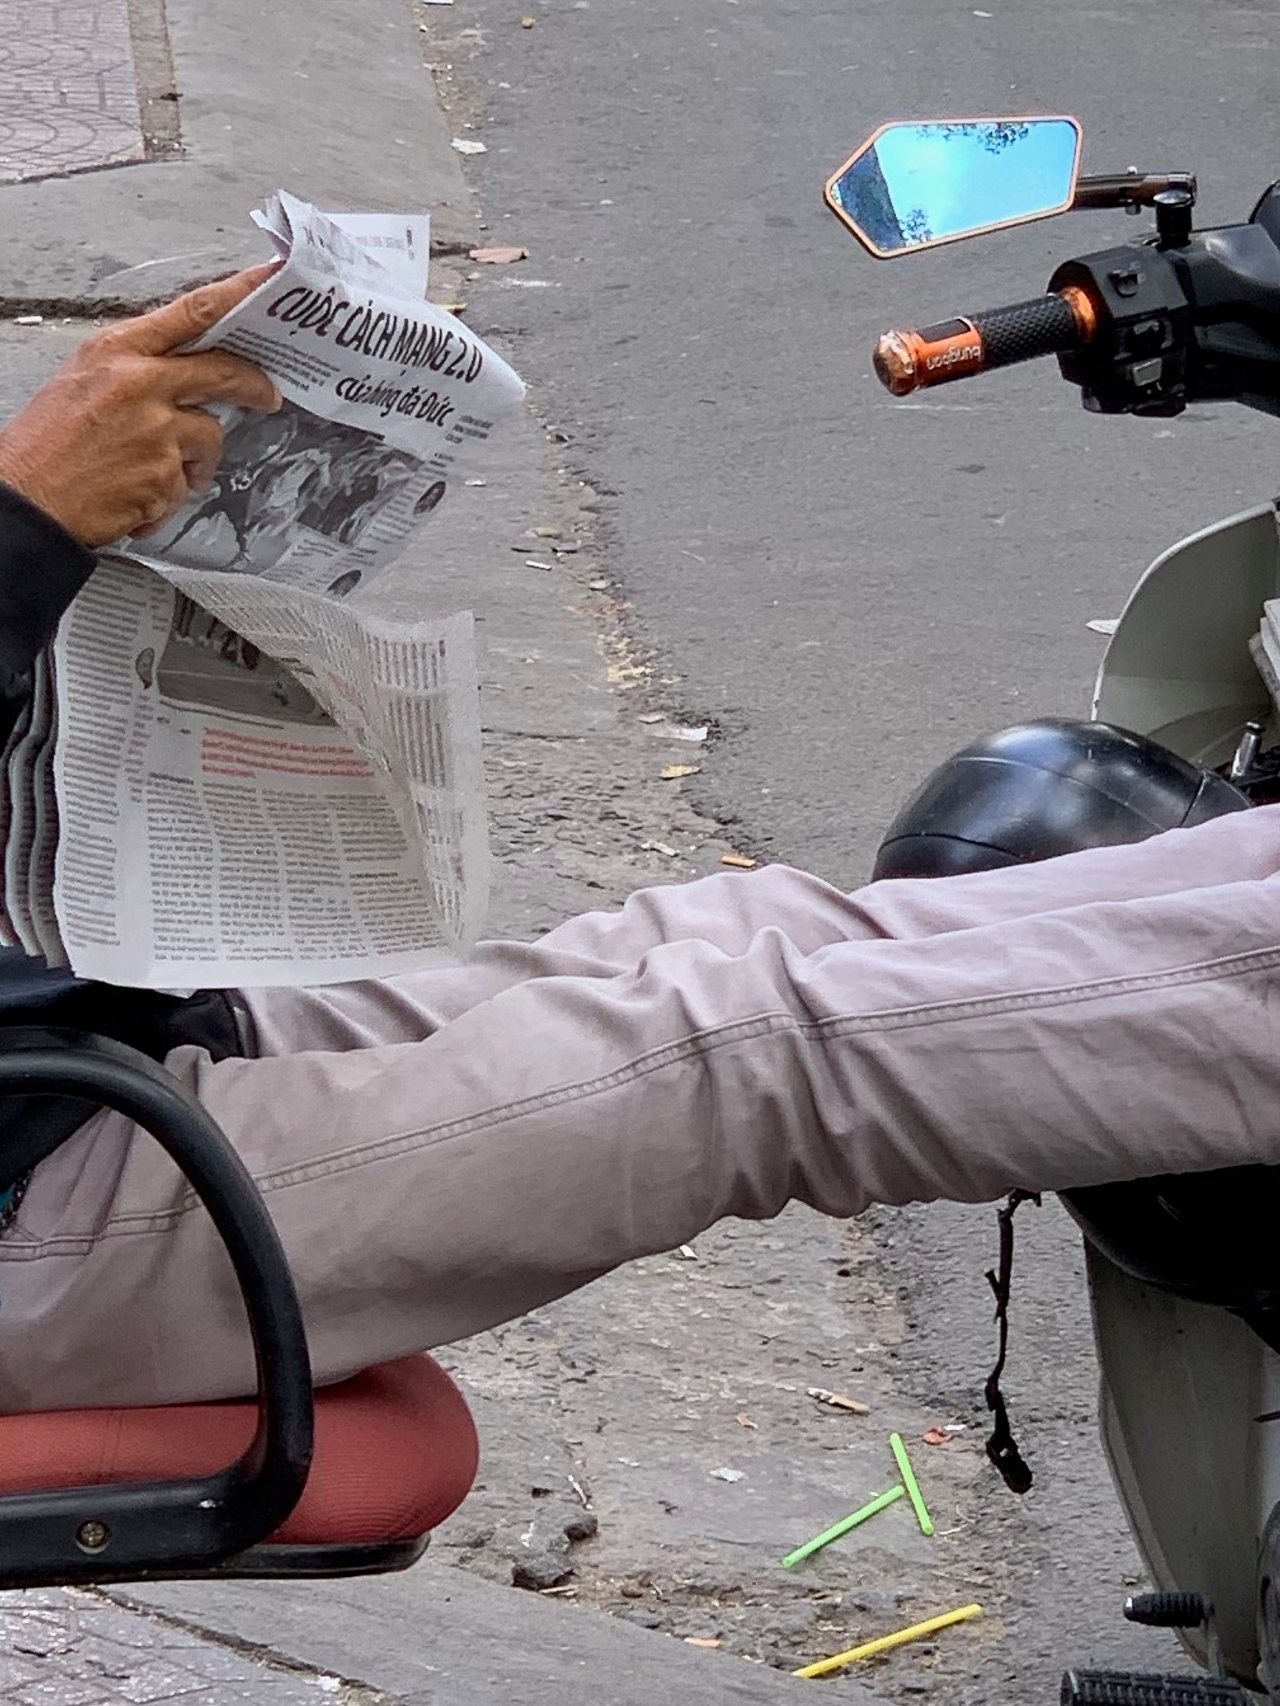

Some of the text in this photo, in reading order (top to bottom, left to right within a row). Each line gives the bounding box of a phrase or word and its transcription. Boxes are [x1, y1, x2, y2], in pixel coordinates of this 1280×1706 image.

[267, 286, 350, 337] CUỘC
[335, 300, 398, 360] CÁCH
[393, 318, 458, 377] MẠNG
[443, 336, 483, 384] 2.0
[398, 385, 424, 418] đá
[418, 392, 455, 428] Đức
